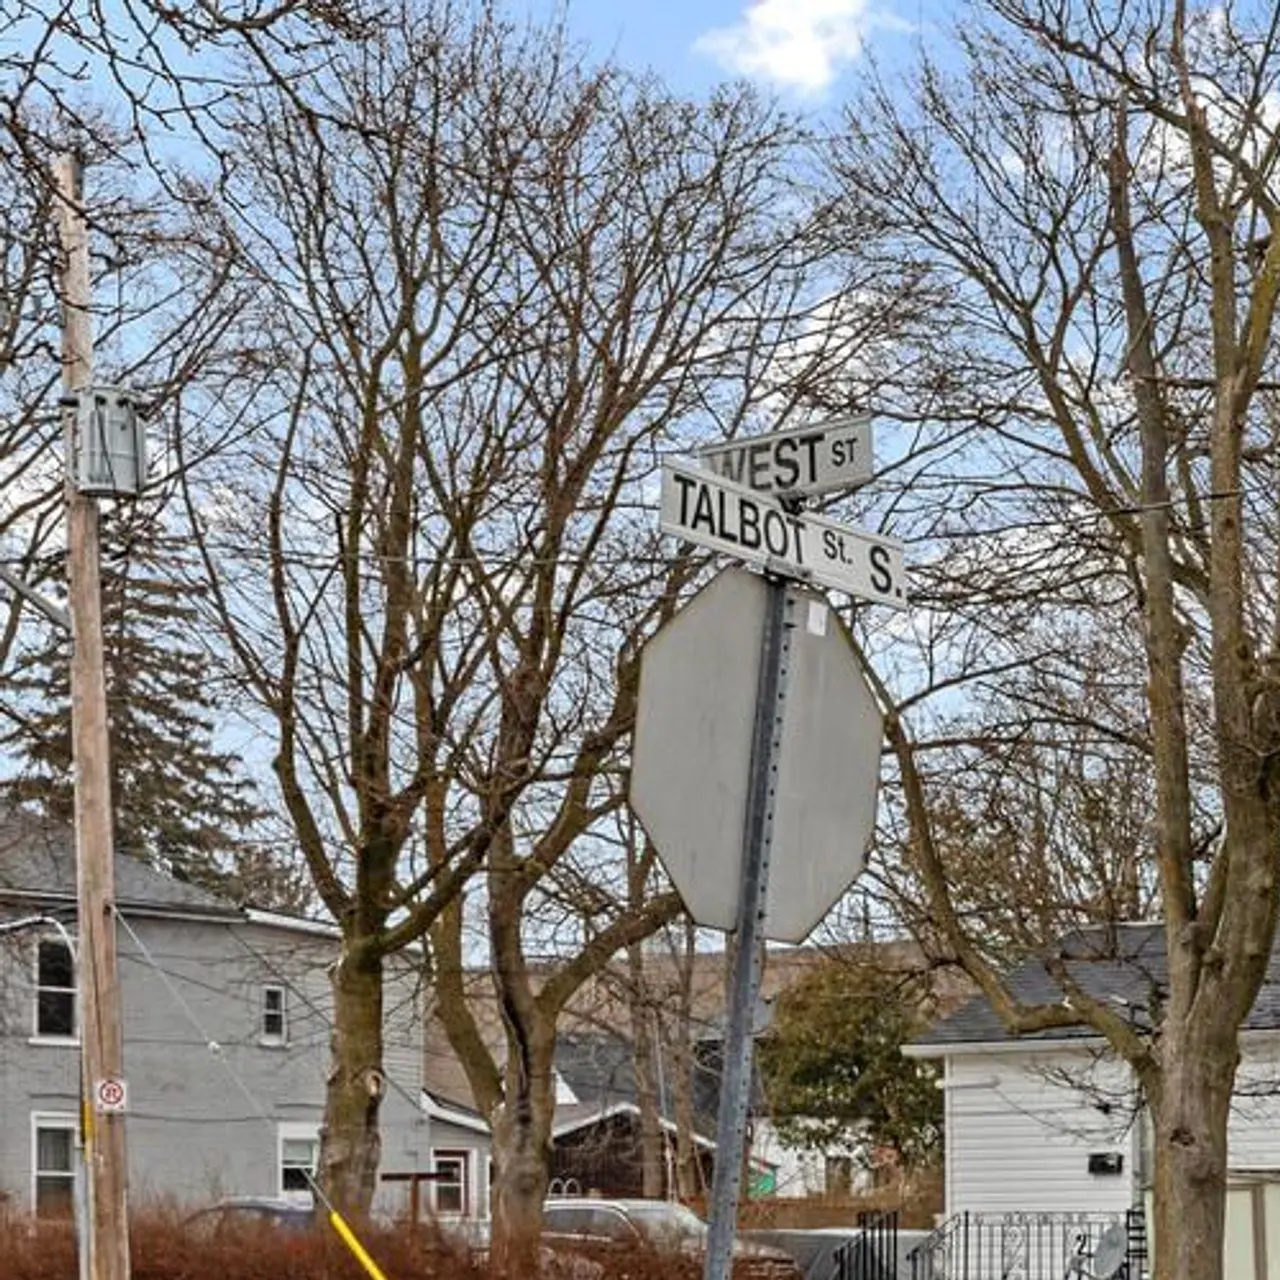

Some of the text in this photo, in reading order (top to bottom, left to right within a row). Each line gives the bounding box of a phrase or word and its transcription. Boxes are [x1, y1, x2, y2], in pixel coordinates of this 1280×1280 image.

[832, 437, 858, 468] ST
[673, 473, 901, 598] TALBOT St. S.
